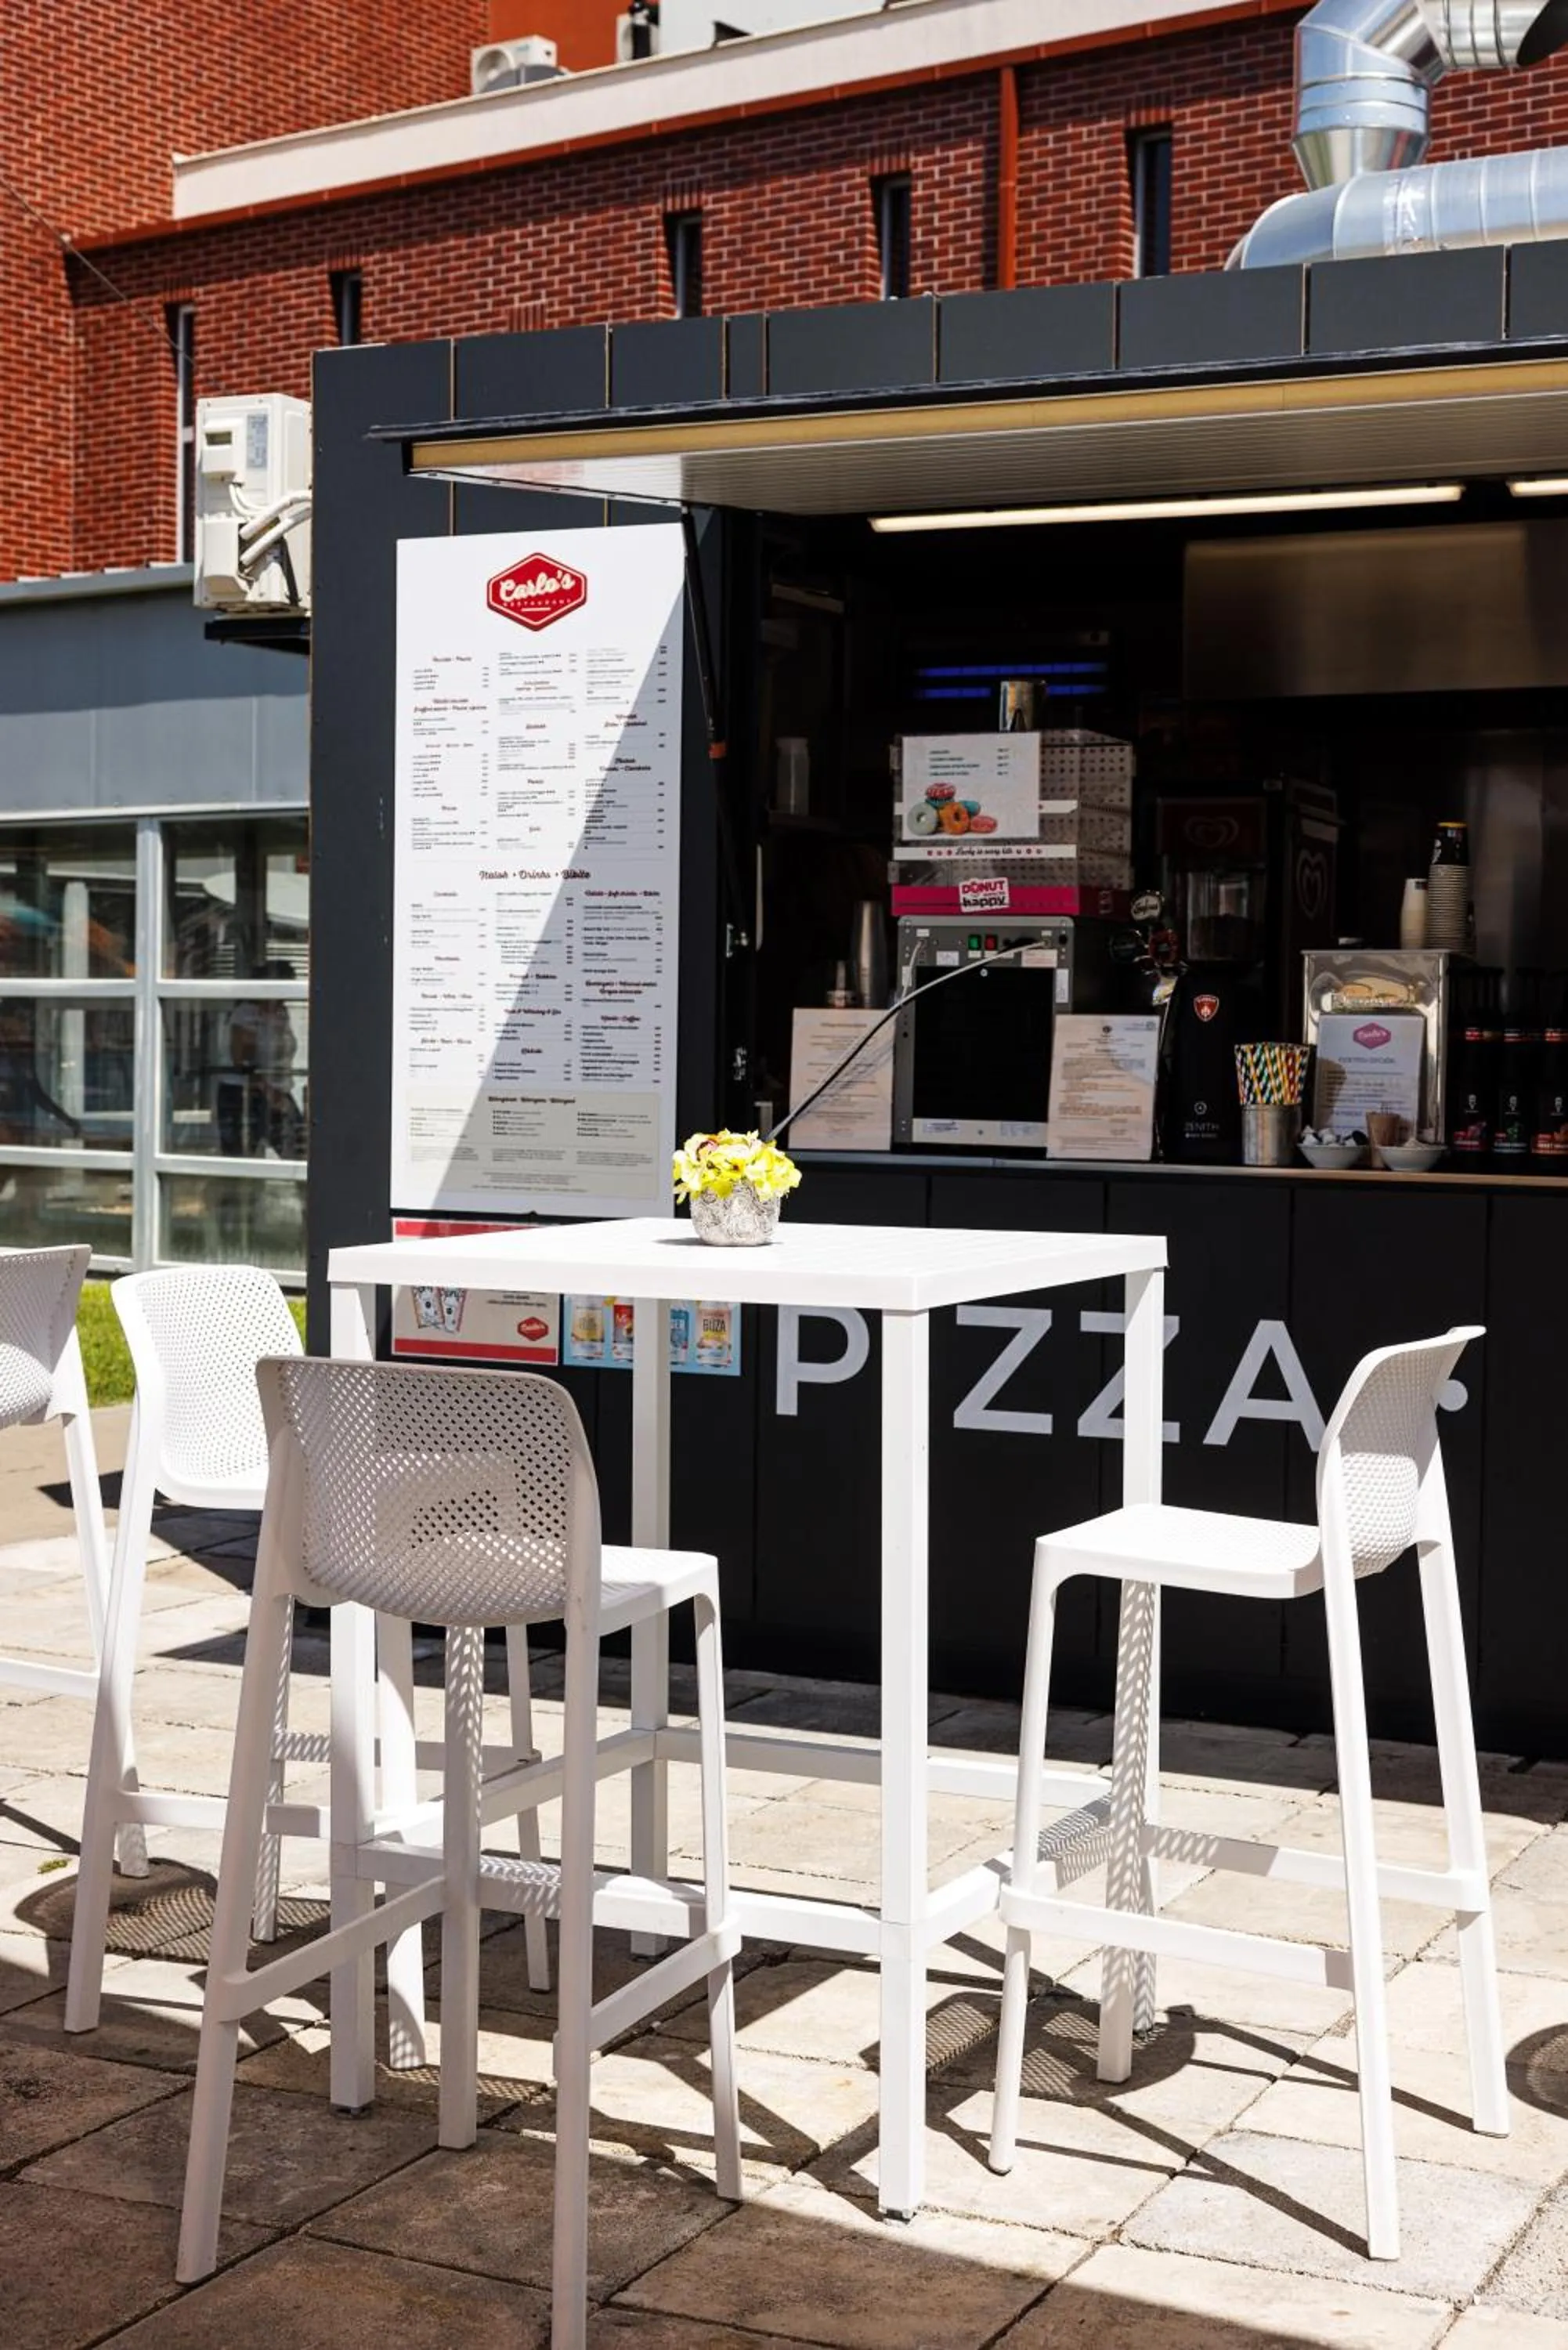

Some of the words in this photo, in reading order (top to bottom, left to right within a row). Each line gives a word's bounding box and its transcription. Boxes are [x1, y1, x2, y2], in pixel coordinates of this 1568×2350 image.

[499, 569, 576, 602] Carlo's
[519, 870, 551, 880] Drinks
[962, 880, 1005, 894] DONUT
[963, 895, 1006, 908] happy
[776, 1305, 1327, 1449] PZZA
